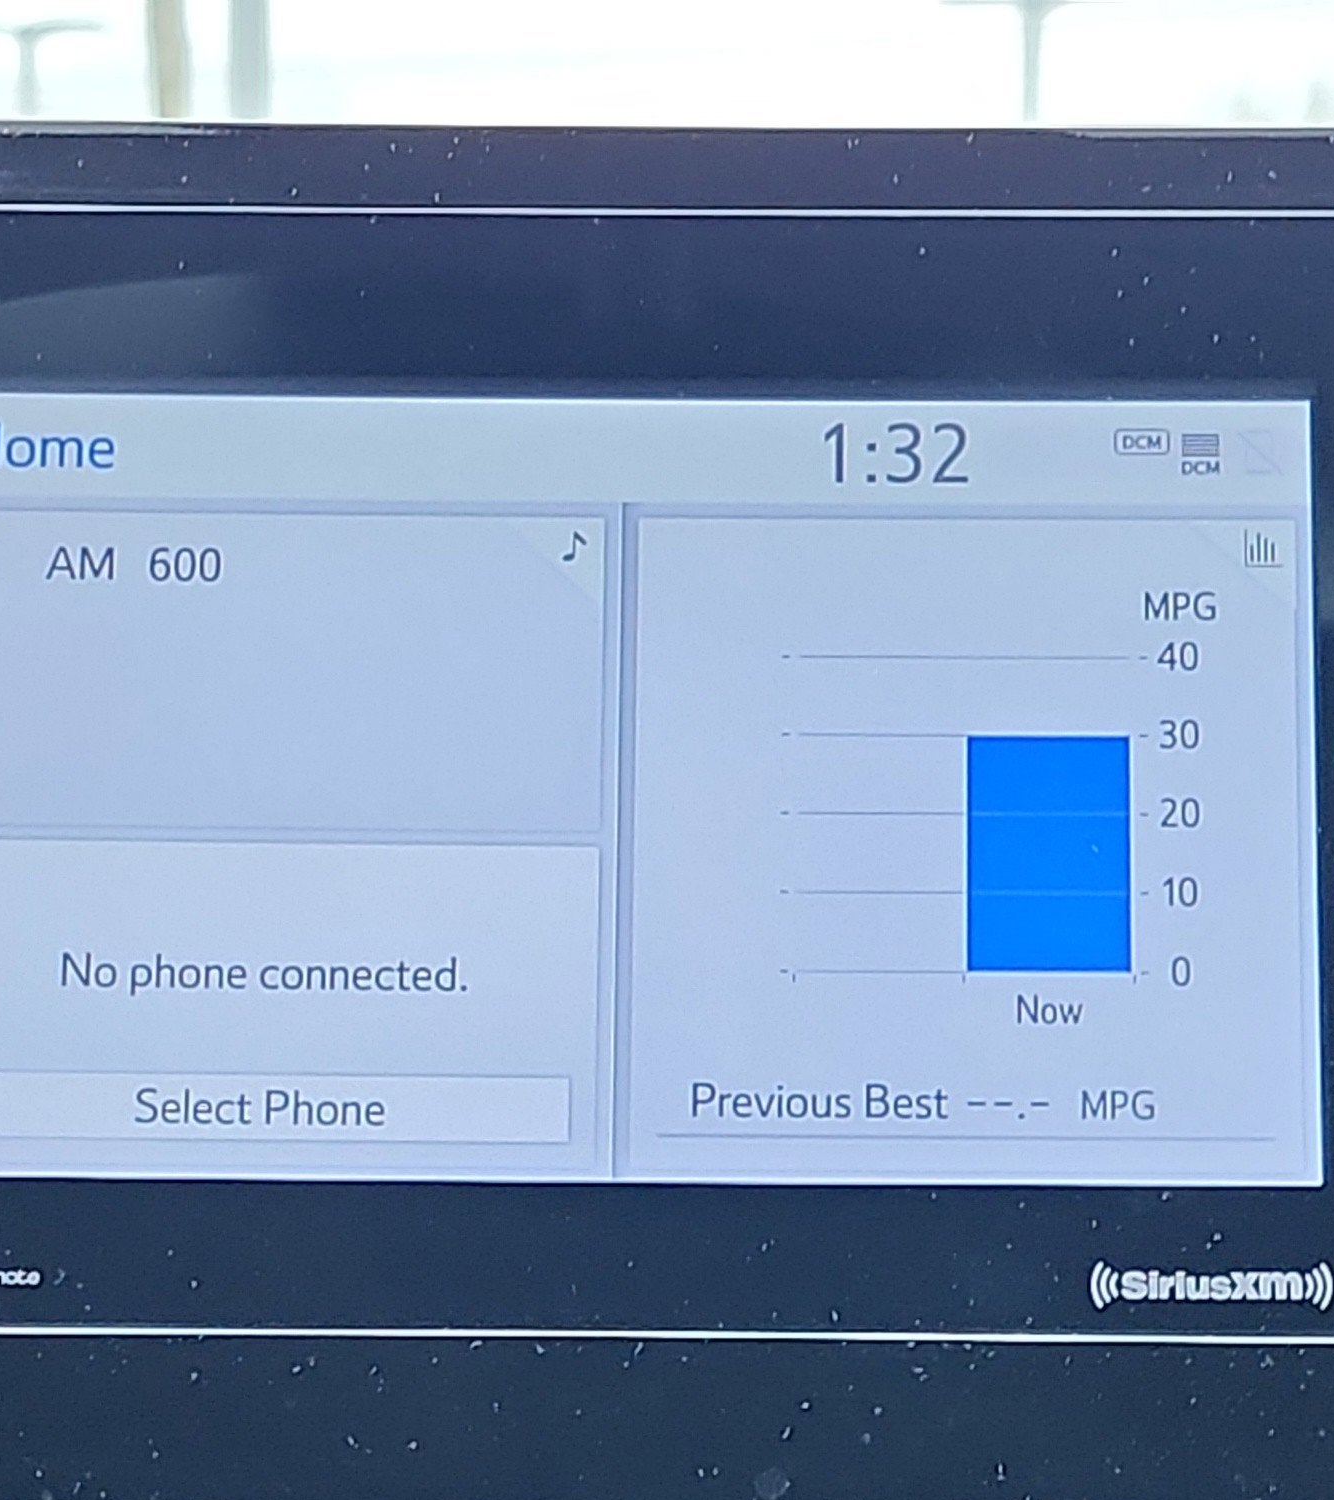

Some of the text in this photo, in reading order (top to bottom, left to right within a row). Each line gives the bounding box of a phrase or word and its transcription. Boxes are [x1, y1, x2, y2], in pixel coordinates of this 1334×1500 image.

[823, 422, 970, 485] 1:32
[1122, 435, 1162, 450] DCM
[1181, 460, 1220, 475] DCM
[45, 547, 222, 583] AM 600
[1143, 592, 1218, 622] MPG
[1156, 641, 1200, 672] 40
[1158, 719, 1201, 751] 30
[1159, 798, 1201, 829] 20
[1162, 877, 1199, 908] 10
[59, 952, 469, 997] No phone connected.
[1170, 956, 1192, 987] 0
[1015, 995, 1084, 1026] Now
[133, 1088, 386, 1127] Select Phone
[690, 1082, 852, 1120] Previous
[865, 1083, 949, 1120] Best
[1079, 1090, 1157, 1122] MPG
